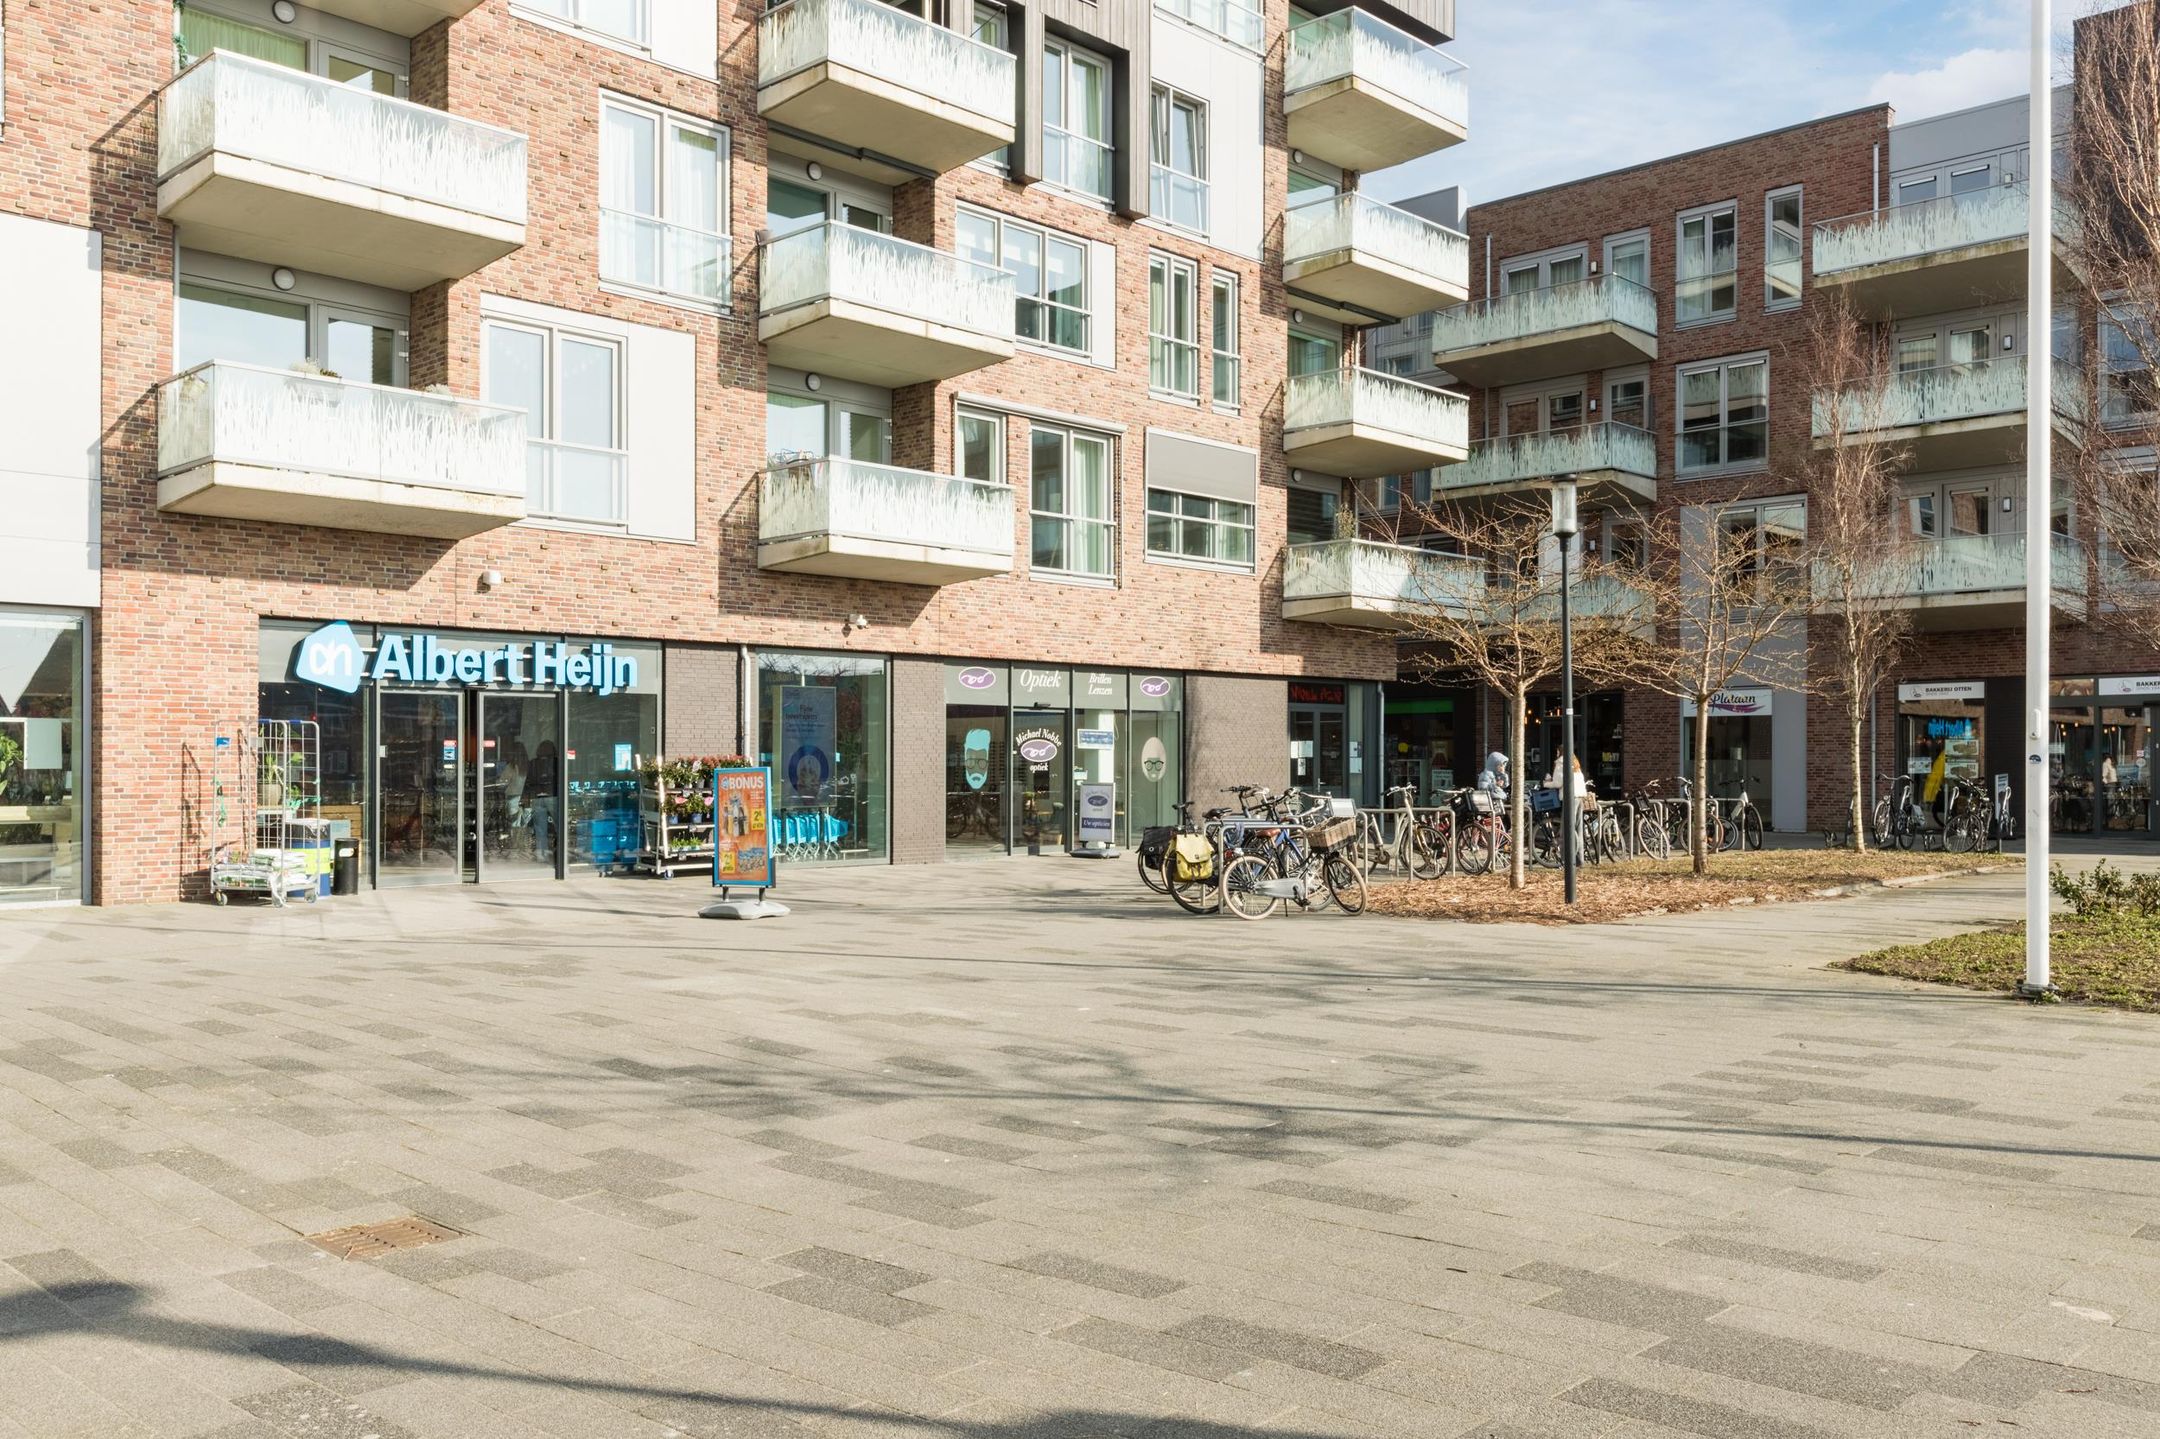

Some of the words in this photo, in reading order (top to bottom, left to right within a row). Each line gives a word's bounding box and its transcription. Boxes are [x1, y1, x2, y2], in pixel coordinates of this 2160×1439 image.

[371, 633, 524, 684] Albert
[531, 640, 638, 696] Heijn
[1020, 669, 1061, 692] Optiek
[1088, 672, 1112, 684] Brillen
[1088, 684, 1113, 695] Lenzen
[1710, 692, 1756, 711] Plataan
[1015, 728, 1042, 746] Michael
[1042, 728, 1063, 747] Nobbe
[1029, 762, 1049, 773] optiek
[729, 776, 764, 789] BONUS
